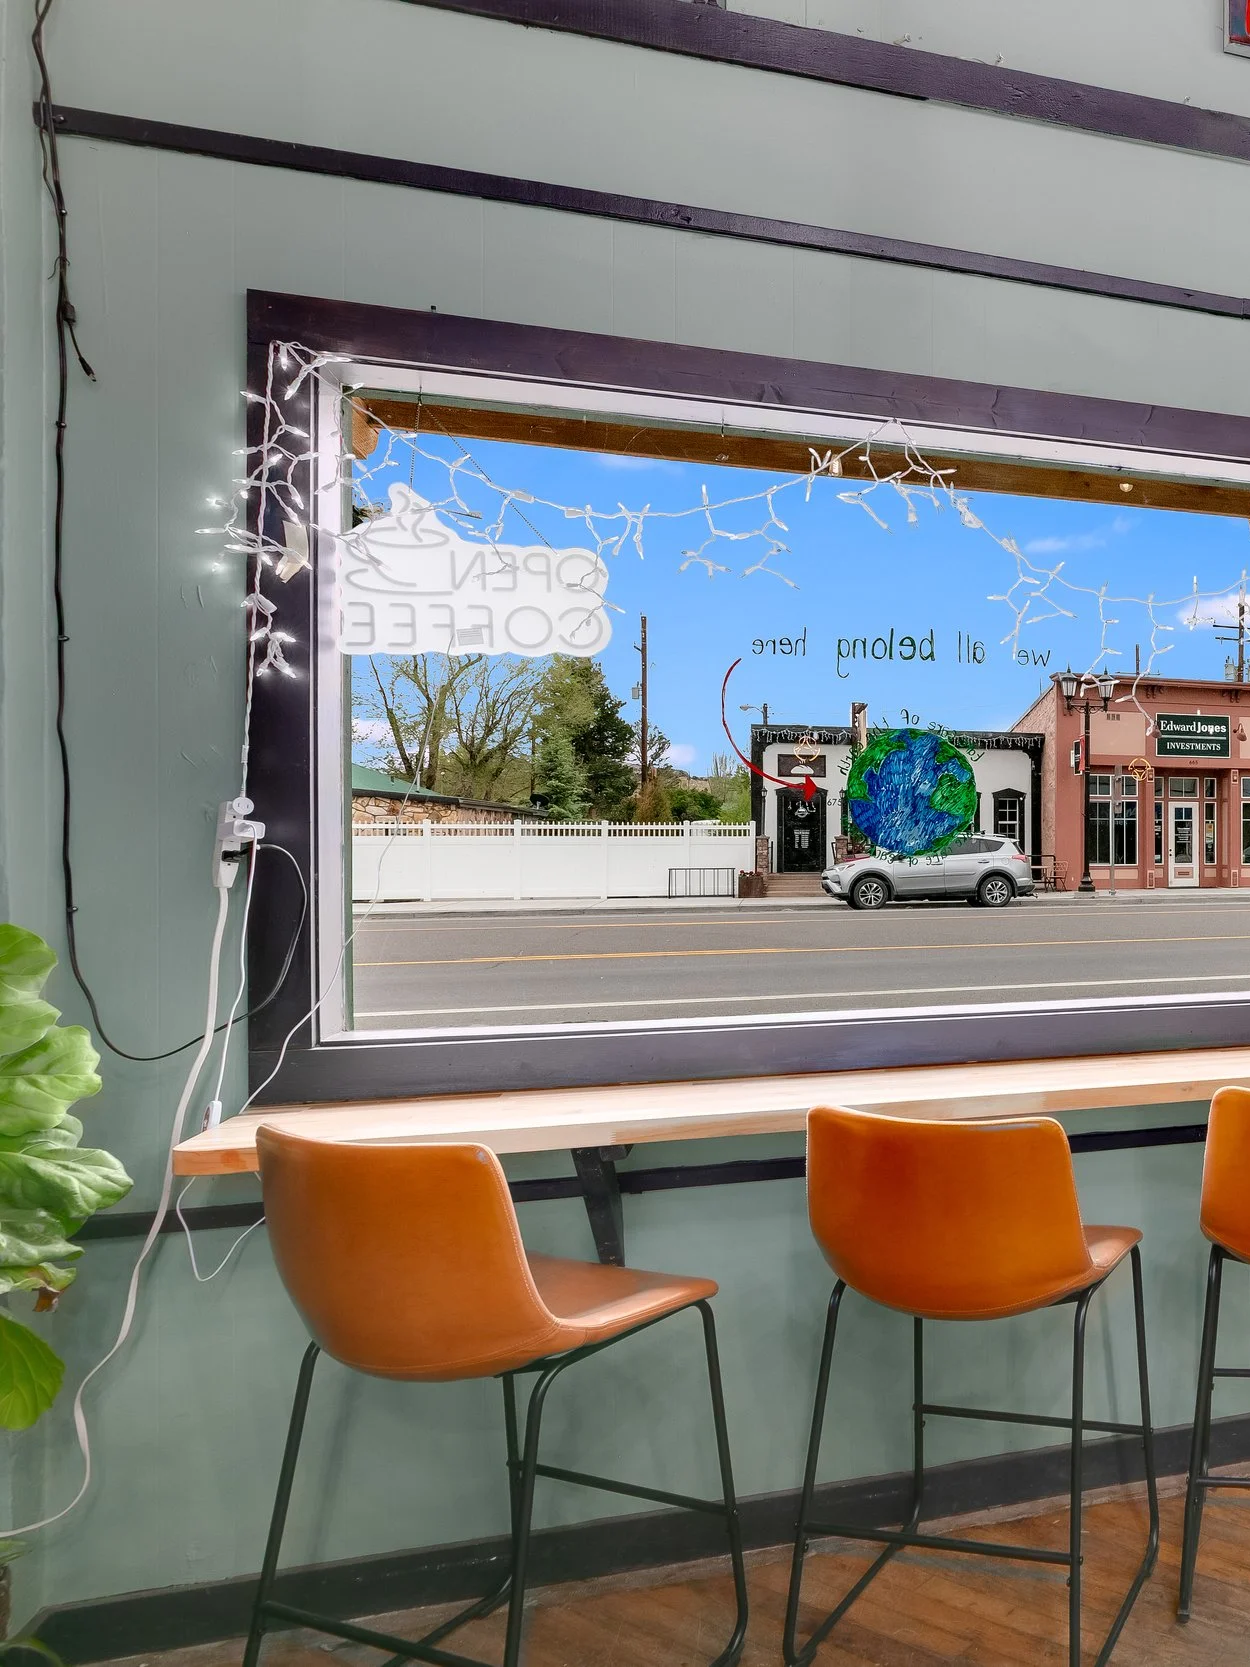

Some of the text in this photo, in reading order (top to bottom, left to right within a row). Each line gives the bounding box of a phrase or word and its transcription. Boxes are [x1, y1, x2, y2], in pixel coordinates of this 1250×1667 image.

[1160, 720, 1227, 733] Edward Jones
[1166, 742, 1221, 751] INVESTMENTS
